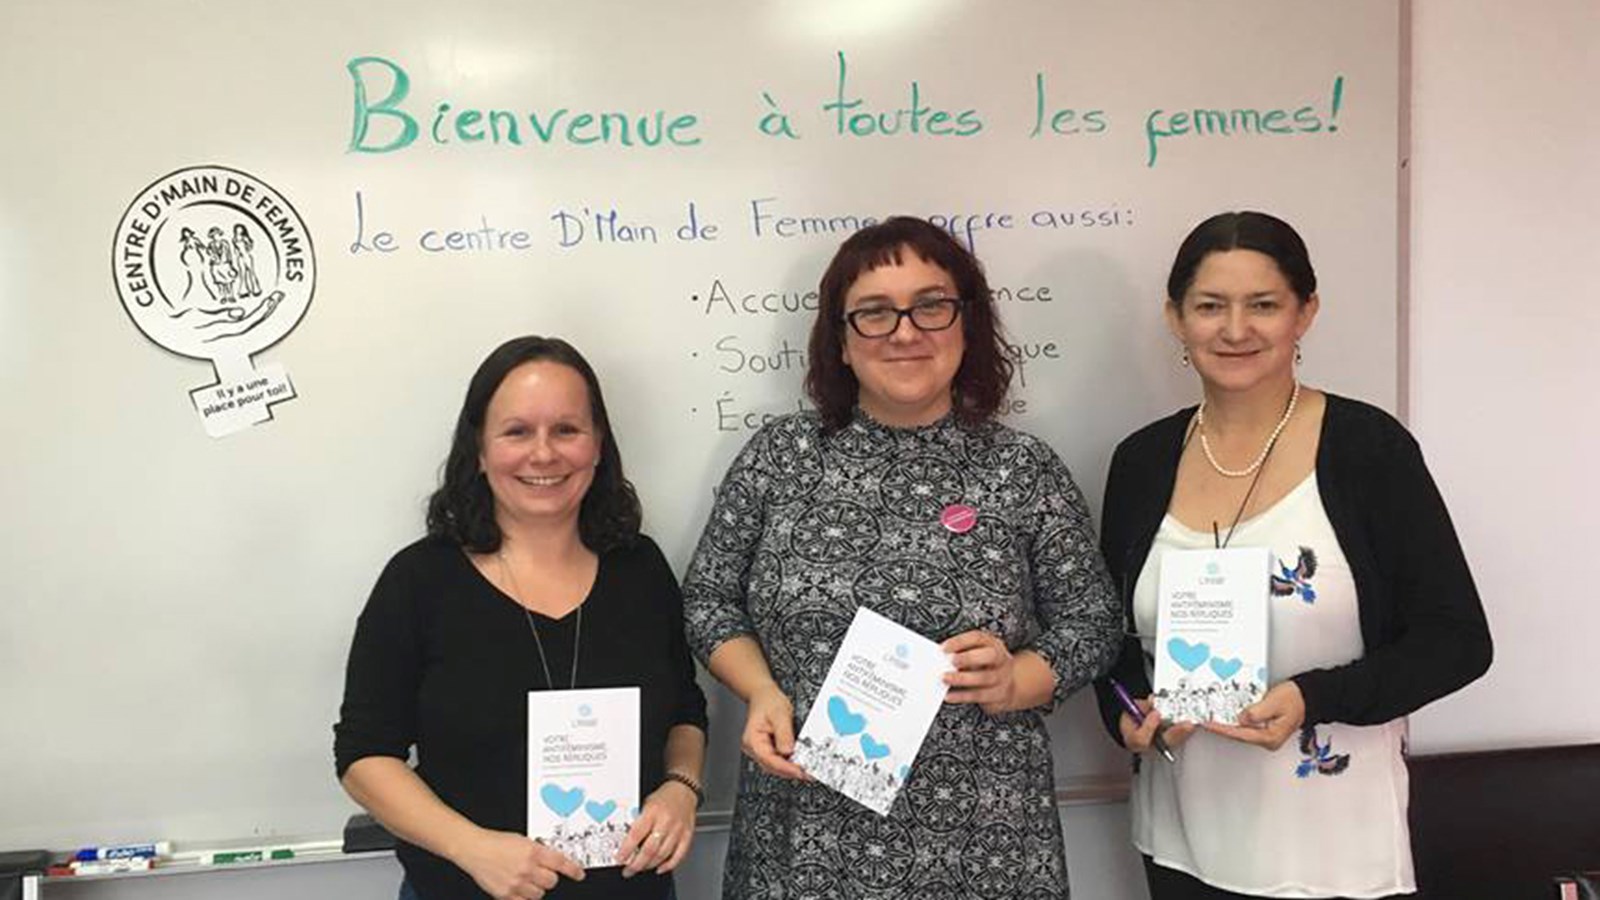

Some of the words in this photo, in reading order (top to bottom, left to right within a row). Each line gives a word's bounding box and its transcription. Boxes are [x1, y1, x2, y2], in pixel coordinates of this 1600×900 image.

[346, 56, 702, 155] Bienvenue
[757, 92, 801, 139] à
[823, 51, 984, 136] toutes
[1029, 73, 1108, 138] les
[1146, 76, 1344, 167] femmes!
[124, 218, 154, 307] CENTRE
[141, 175, 218, 220] D'MAIN
[225, 178, 255, 204] DE
[256, 195, 304, 282] FEMMES
[350, 191, 400, 253] Le
[420, 214, 532, 251] centre
[551, 207, 658, 247] D'Main
[677, 202, 718, 240] de
[751, 198, 879, 238] Femme
[1031, 202, 1134, 229] aussi:
[705, 279, 821, 315] Accue
[715, 335, 806, 374] Souti
[203, 401, 235, 418] place
[237, 392, 264, 407] pour
[237, 385, 244, 393] a
[246, 378, 269, 391] une
